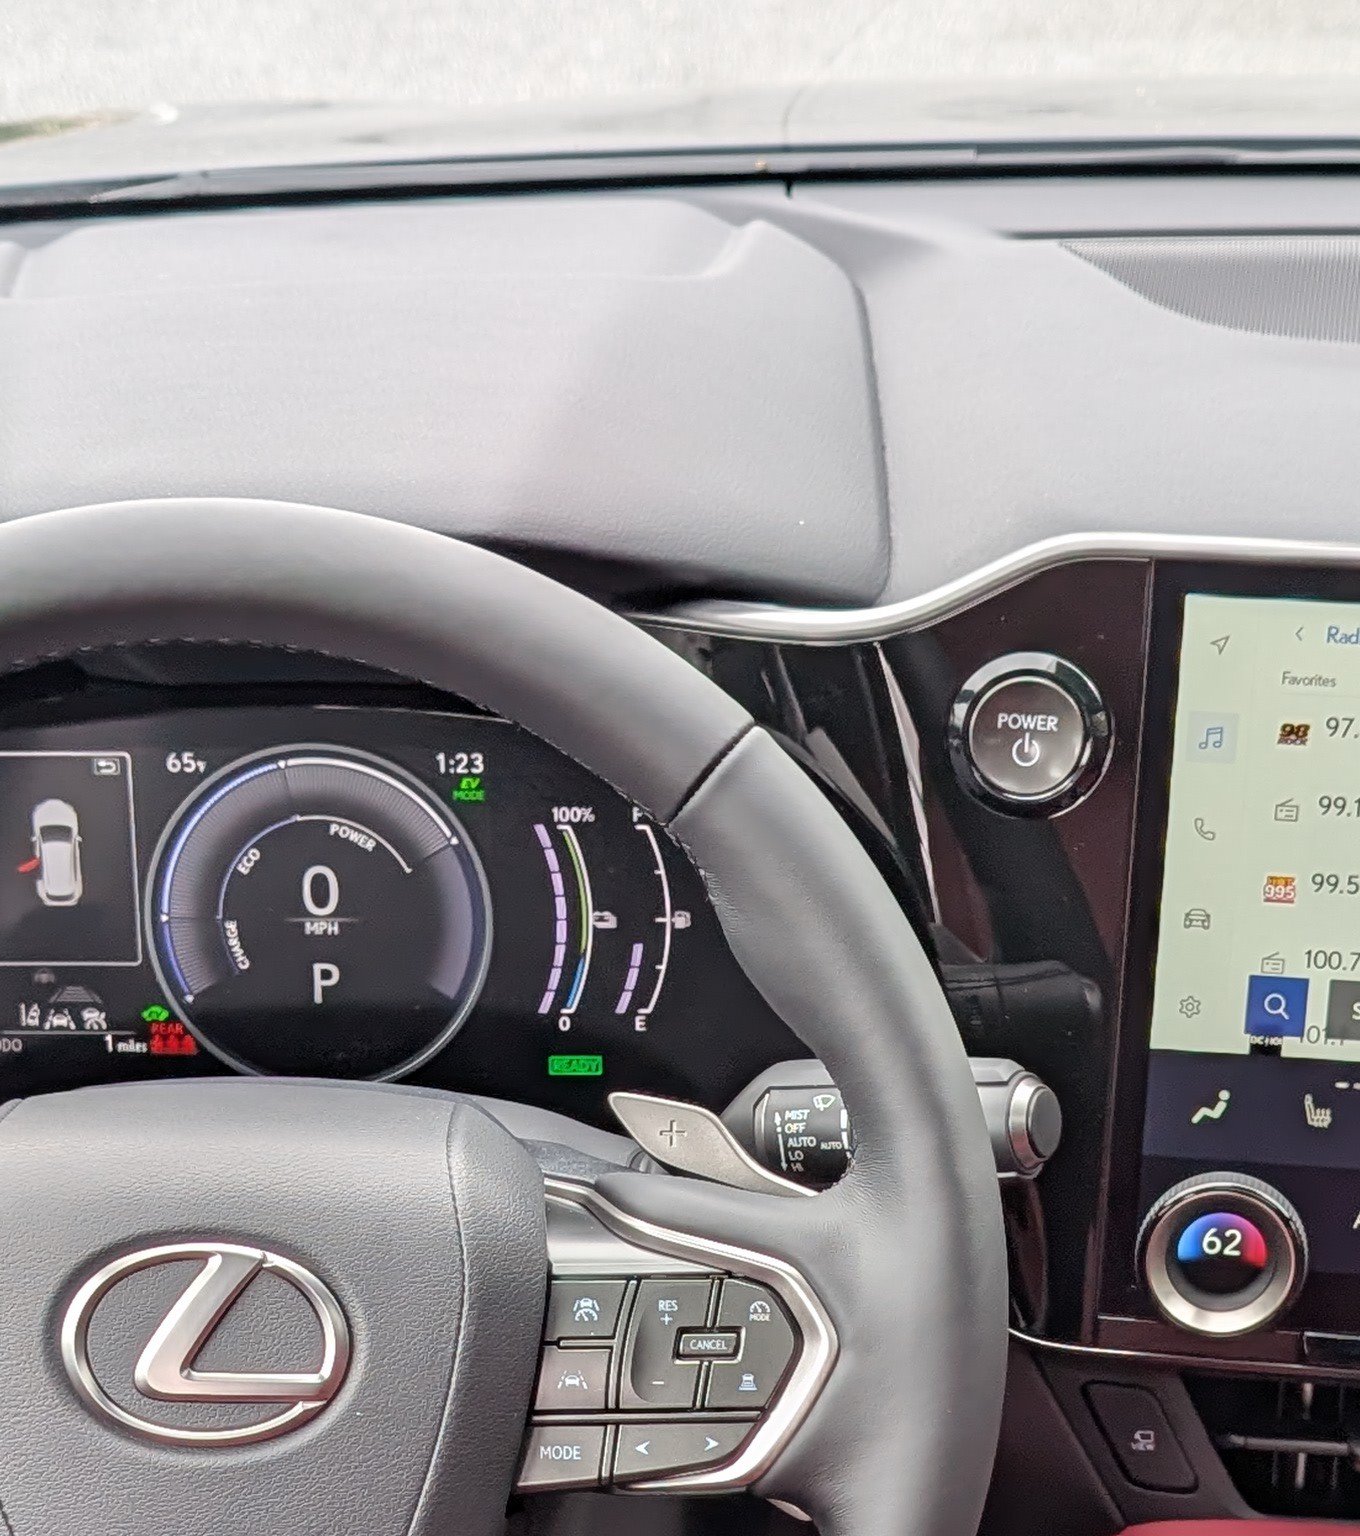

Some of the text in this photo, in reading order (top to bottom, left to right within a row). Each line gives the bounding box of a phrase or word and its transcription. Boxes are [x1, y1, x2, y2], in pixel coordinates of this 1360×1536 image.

[1281, 670, 1338, 689] Favorites
[997, 712, 1059, 732] POWER
[435, 751, 486, 775] 1:23
[550, 806, 596, 823] 100%
[328, 822, 378, 853] POWER
[236, 847, 261, 875] ECO
[301, 864, 340, 917] 0
[1311, 872, 1360, 896] 99.5
[304, 921, 340, 936] MPH
[312, 962, 341, 1005] P
[150, 1022, 184, 1035] REAR
[634, 1016, 647, 1033] E
[104, 1033, 114, 1053] 1
[116, 1038, 148, 1053] miles
[784, 1108, 811, 1121] MIST
[784, 1121, 808, 1134] OFF
[786, 1135, 818, 1149] AUTO
[787, 1150, 805, 1162] LO
[1201, 1227, 1242, 1257] 62
[657, 1299, 679, 1312] RES
[748, 1311, 772, 1322] MODE
[689, 1338, 728, 1351] CANCEL
[540, 1445, 582, 1461] MODE
